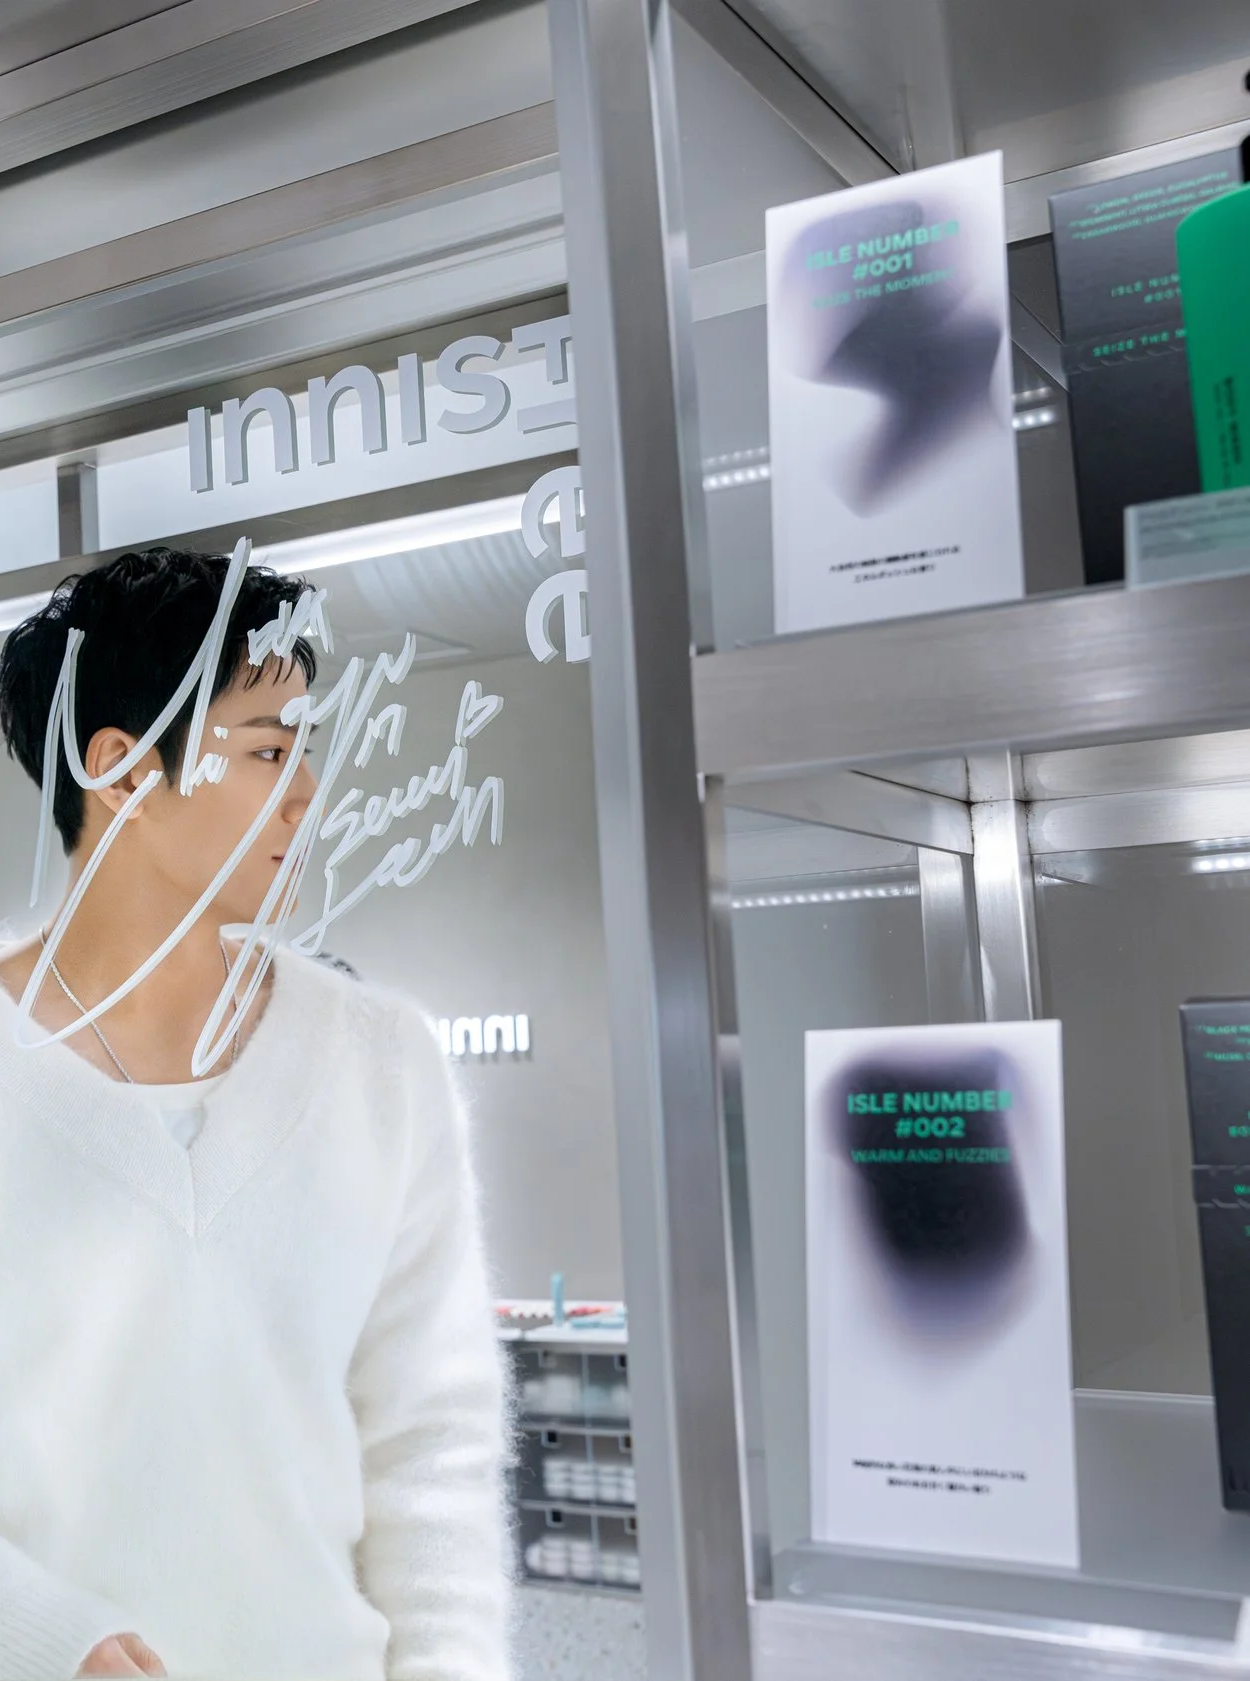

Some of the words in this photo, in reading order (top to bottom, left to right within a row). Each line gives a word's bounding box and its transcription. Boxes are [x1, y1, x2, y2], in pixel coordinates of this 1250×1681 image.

[856, 219, 960, 260] NUMBER
[853, 252, 914, 281] #001
[847, 1092, 898, 1114] ISLE
[902, 1089, 1012, 1114] NUMBER
[895, 1116, 965, 1138] #002
[851, 1149, 904, 1163] WARM
[906, 1148, 944, 1163] AND
[945, 1147, 1010, 1163] FUZZIES
